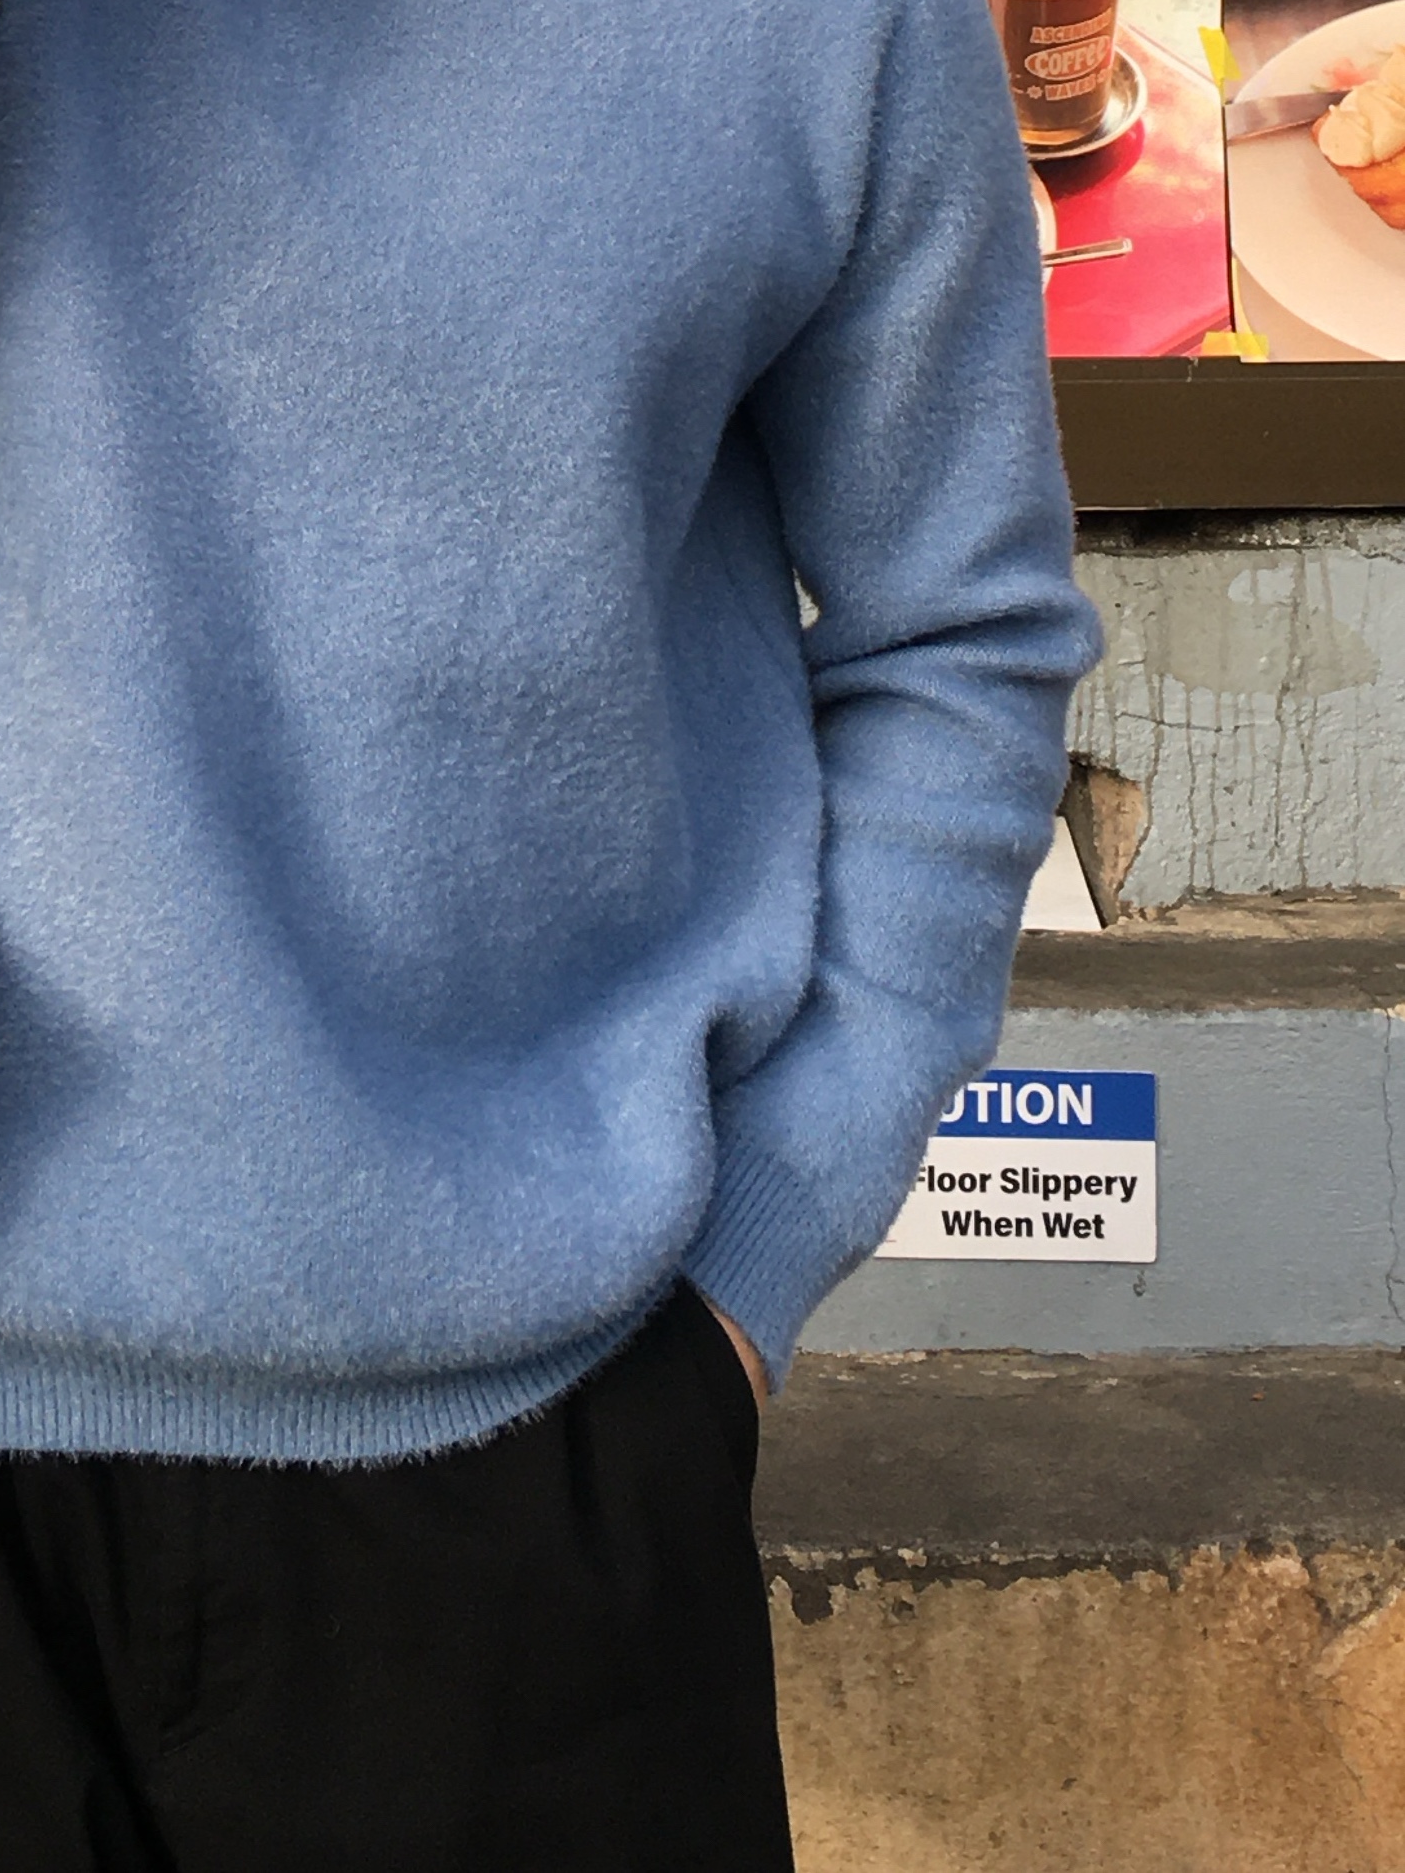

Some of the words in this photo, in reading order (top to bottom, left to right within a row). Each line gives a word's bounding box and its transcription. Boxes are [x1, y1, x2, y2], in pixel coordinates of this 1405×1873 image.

[939, 1082, 1093, 1126] UTION
[1000, 1166, 1138, 1203] Slippery
[941, 1209, 1034, 1238] When
[1042, 1211, 1106, 1240] Wet
